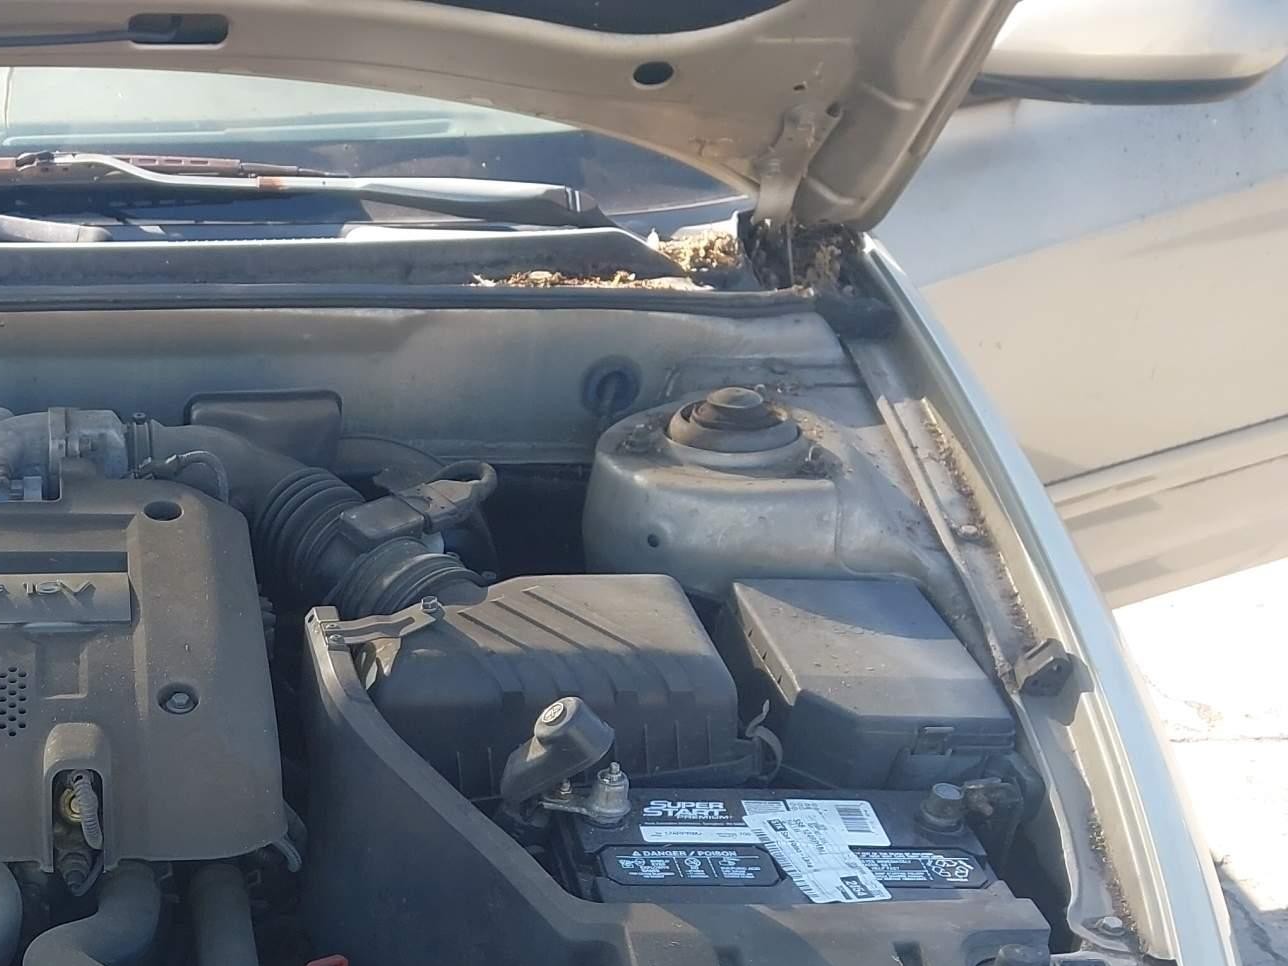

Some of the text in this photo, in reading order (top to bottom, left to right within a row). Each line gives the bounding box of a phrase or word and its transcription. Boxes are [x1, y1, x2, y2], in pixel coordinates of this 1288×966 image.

[23, 579, 97, 596] 16V
[650, 800, 724, 809] SUPER
[643, 808, 726, 817] START
